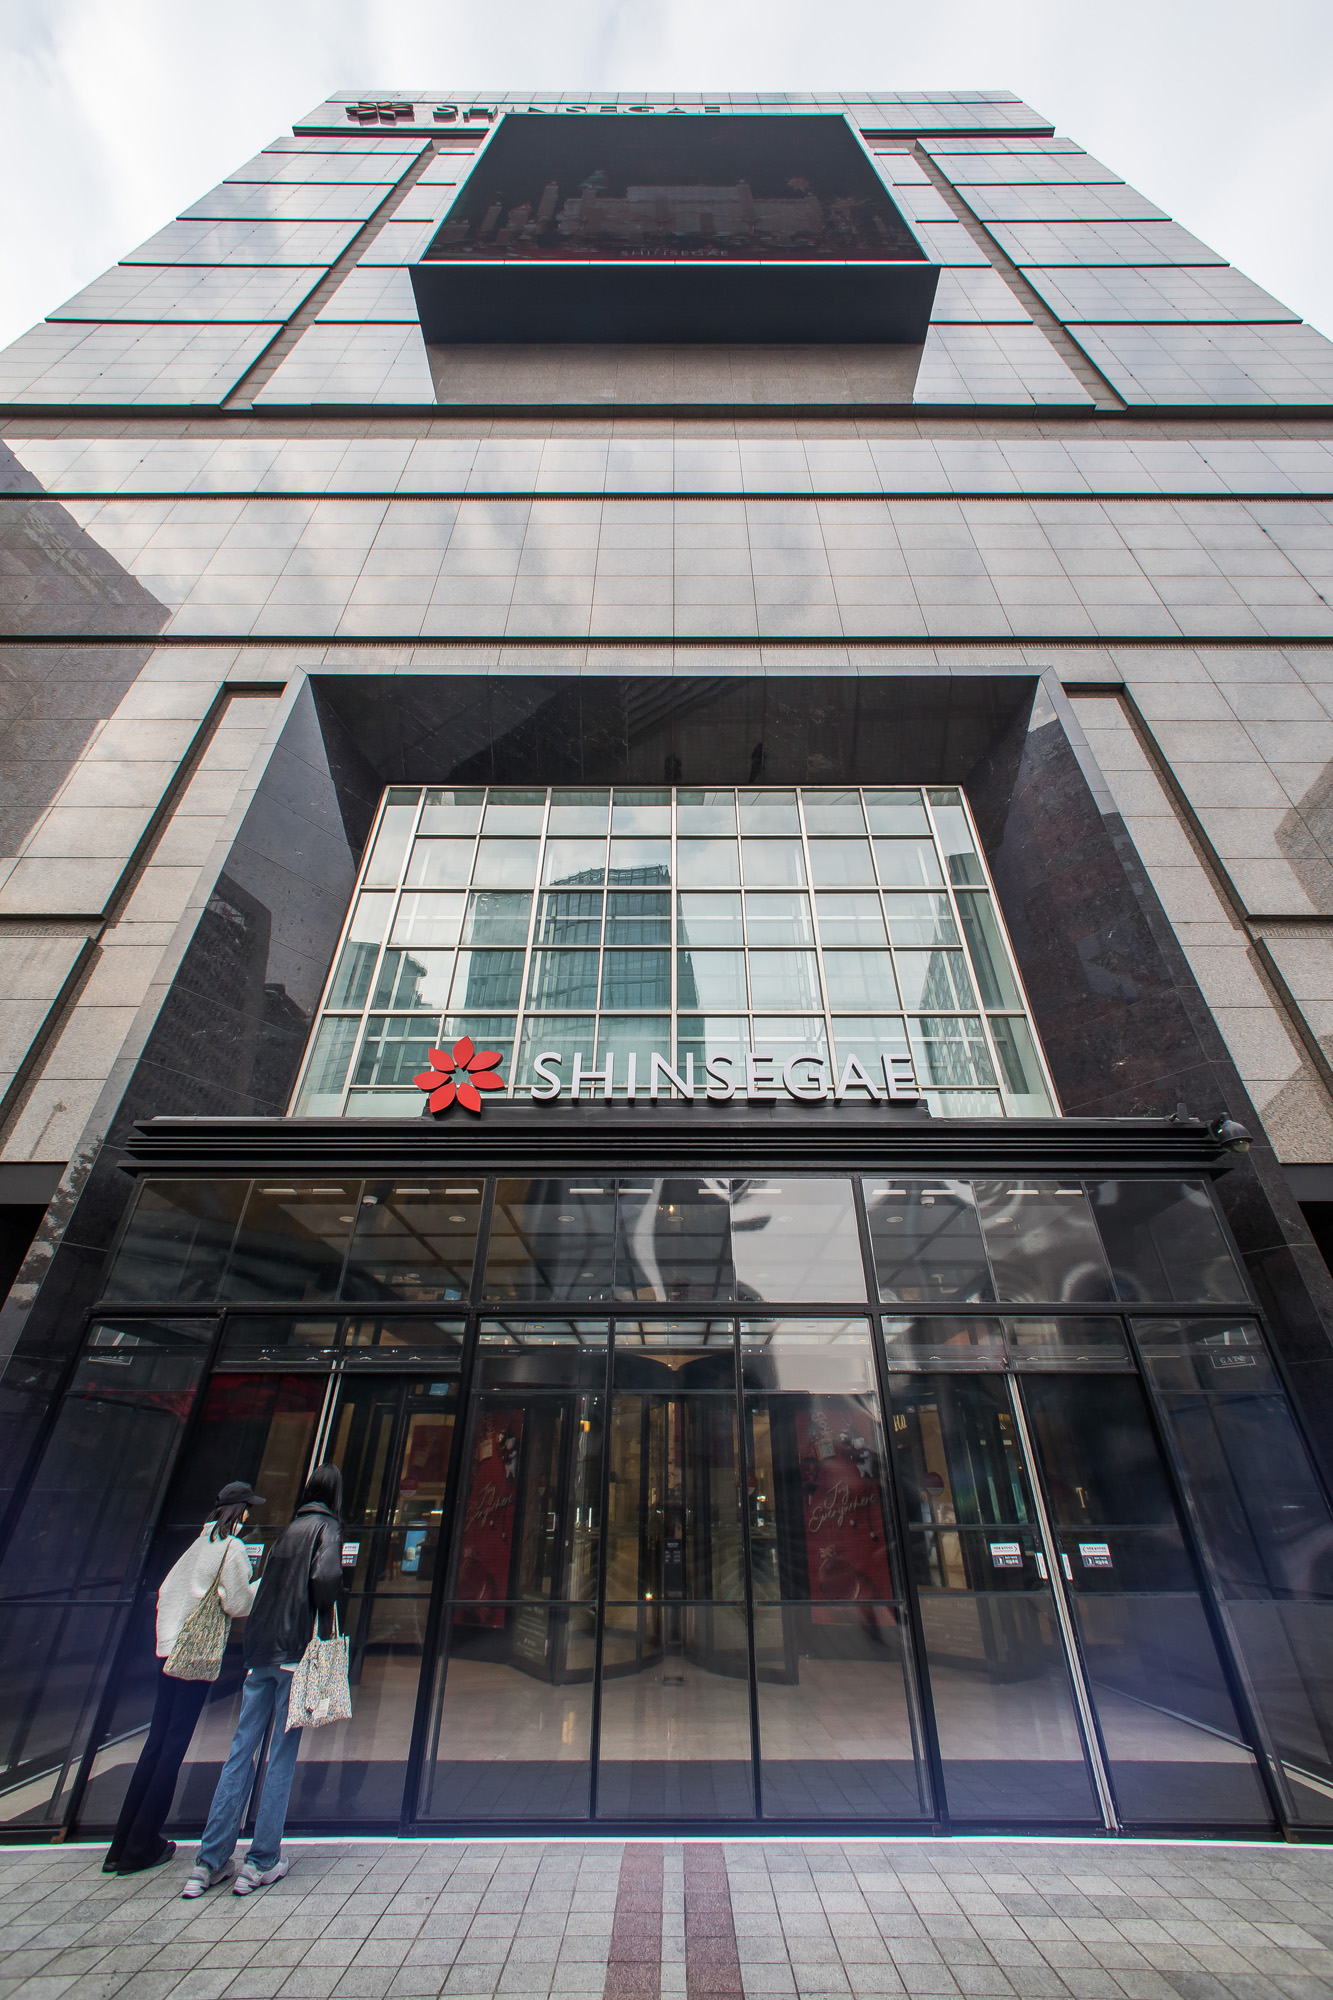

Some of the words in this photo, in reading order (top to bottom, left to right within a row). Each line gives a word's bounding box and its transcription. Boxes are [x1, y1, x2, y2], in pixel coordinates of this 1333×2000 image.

[531, 1051, 918, 1101] SHINSEGAE
[808, 1494, 876, 1533] Everywhere
[824, 1480, 850, 1510] Joy
